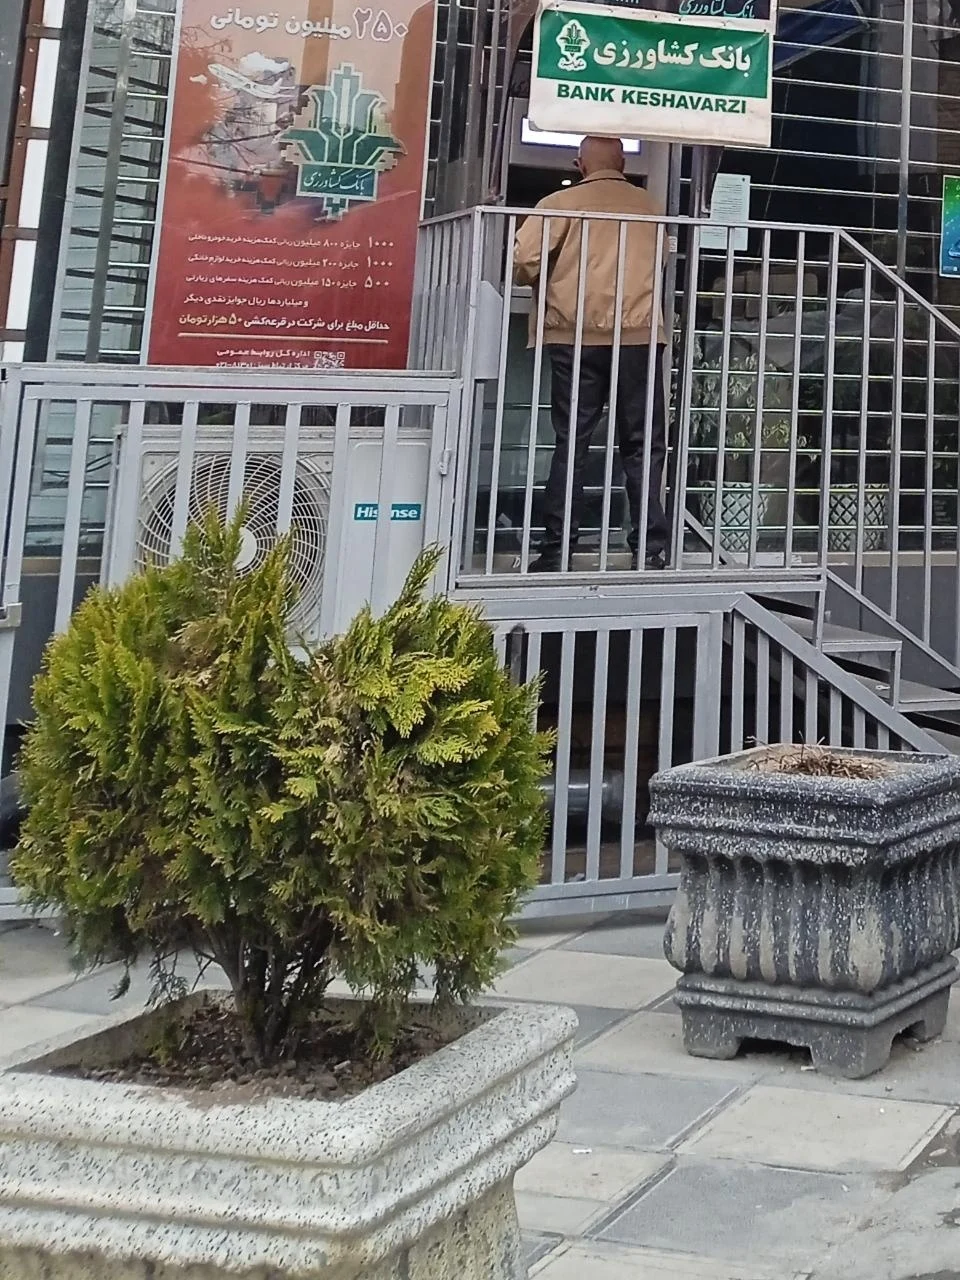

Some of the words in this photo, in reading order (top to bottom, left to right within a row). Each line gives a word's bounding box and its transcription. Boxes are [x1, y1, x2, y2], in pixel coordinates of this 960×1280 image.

[210, 7, 279, 33] تومانی
[353, 7, 409, 42] ۲۵۰
[285, 15, 352, 38] میلیون
[593, 39, 700, 70] کشاورزی
[699, 45, 751, 78] بانک
[557, 83, 615, 103] BANK
[621, 89, 747, 114] KESHAVARZI
[303, 168, 354, 188] کشاورزی
[340, 170, 372, 195] بانک
[293, 238, 321, 248] میلیون
[340, 240, 361, 249] جایزه
[368, 236, 394, 249] ۱۰۰۰
[292, 258, 320, 267] میلیون
[339, 260, 359, 269] جایزه
[367, 255, 393, 268] ۱۰۰۰
[290, 277, 319, 287] میلیون
[337, 280, 357, 288] جایزه
[364, 275, 389, 288] ۵۰۰
[204, 295, 226, 305] نقدی
[226, 295, 247, 305] جوایز
[248, 296, 266, 306] ریال
[179, 313, 209, 325] تومان
[207, 315, 228, 327] هزار
[296, 317, 325, 329] شرکت
[327, 319, 344, 330] برای
[345, 319, 363, 331] مبلغ
[364, 320, 390, 332] حداقل
[357, 506, 418, 518] Hisnse
